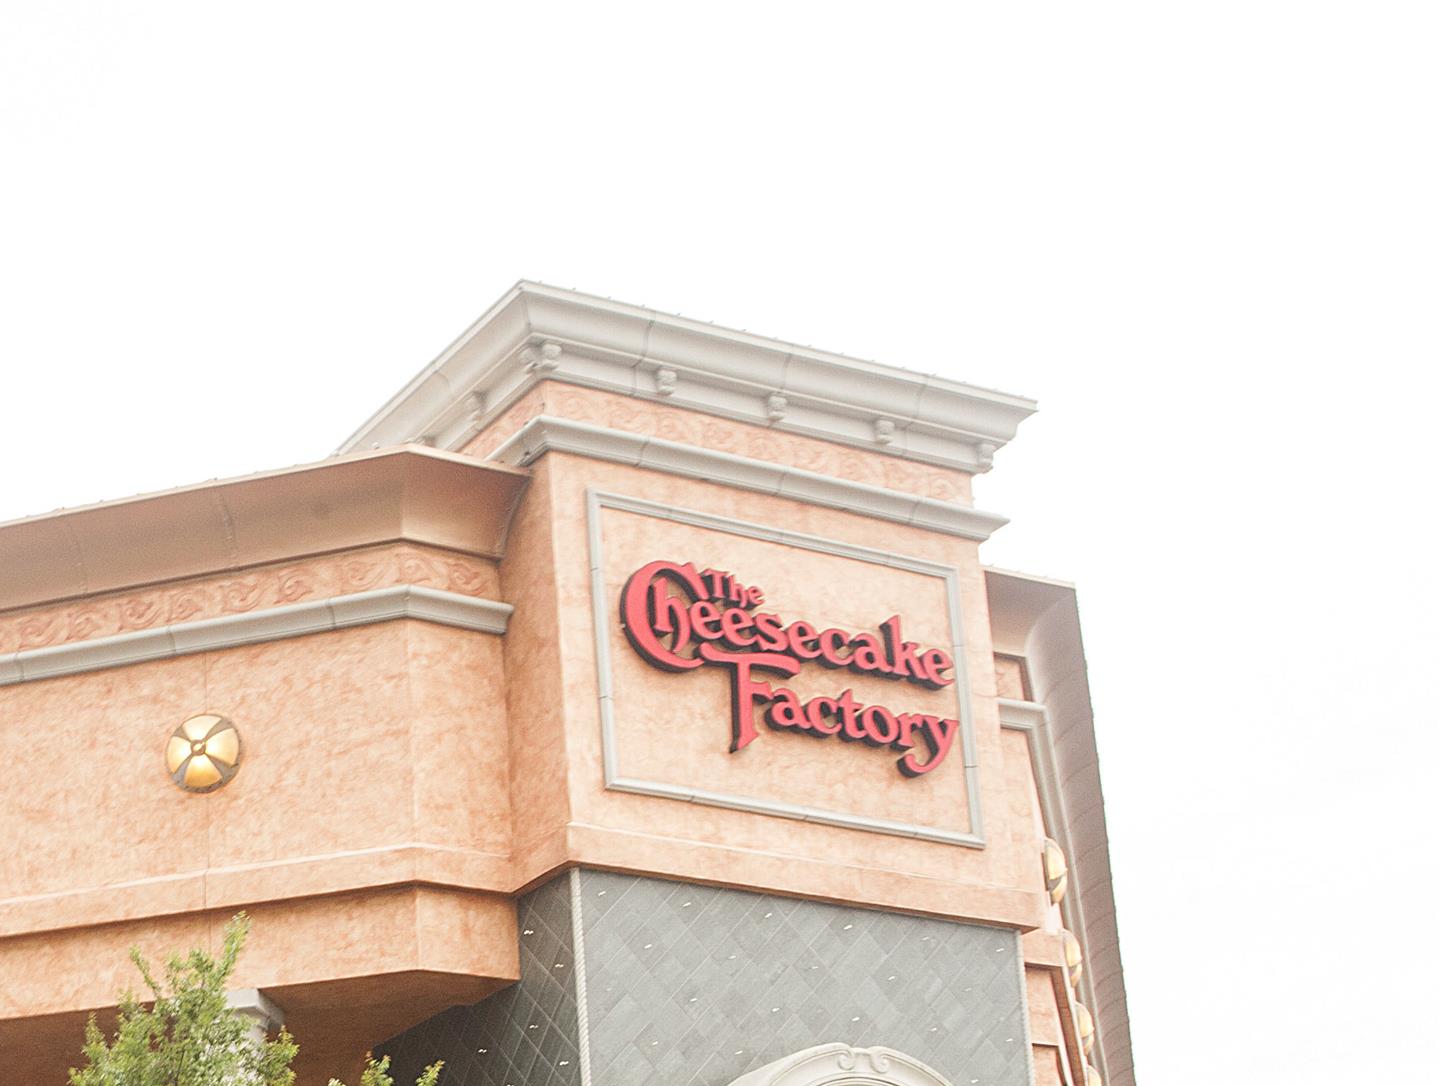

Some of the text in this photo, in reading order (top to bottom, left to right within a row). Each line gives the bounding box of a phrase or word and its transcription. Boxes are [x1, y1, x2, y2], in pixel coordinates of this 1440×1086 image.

[620, 559, 955, 691] Cheesecake
[704, 568, 764, 609] The
[698, 642, 960, 778] Factory
